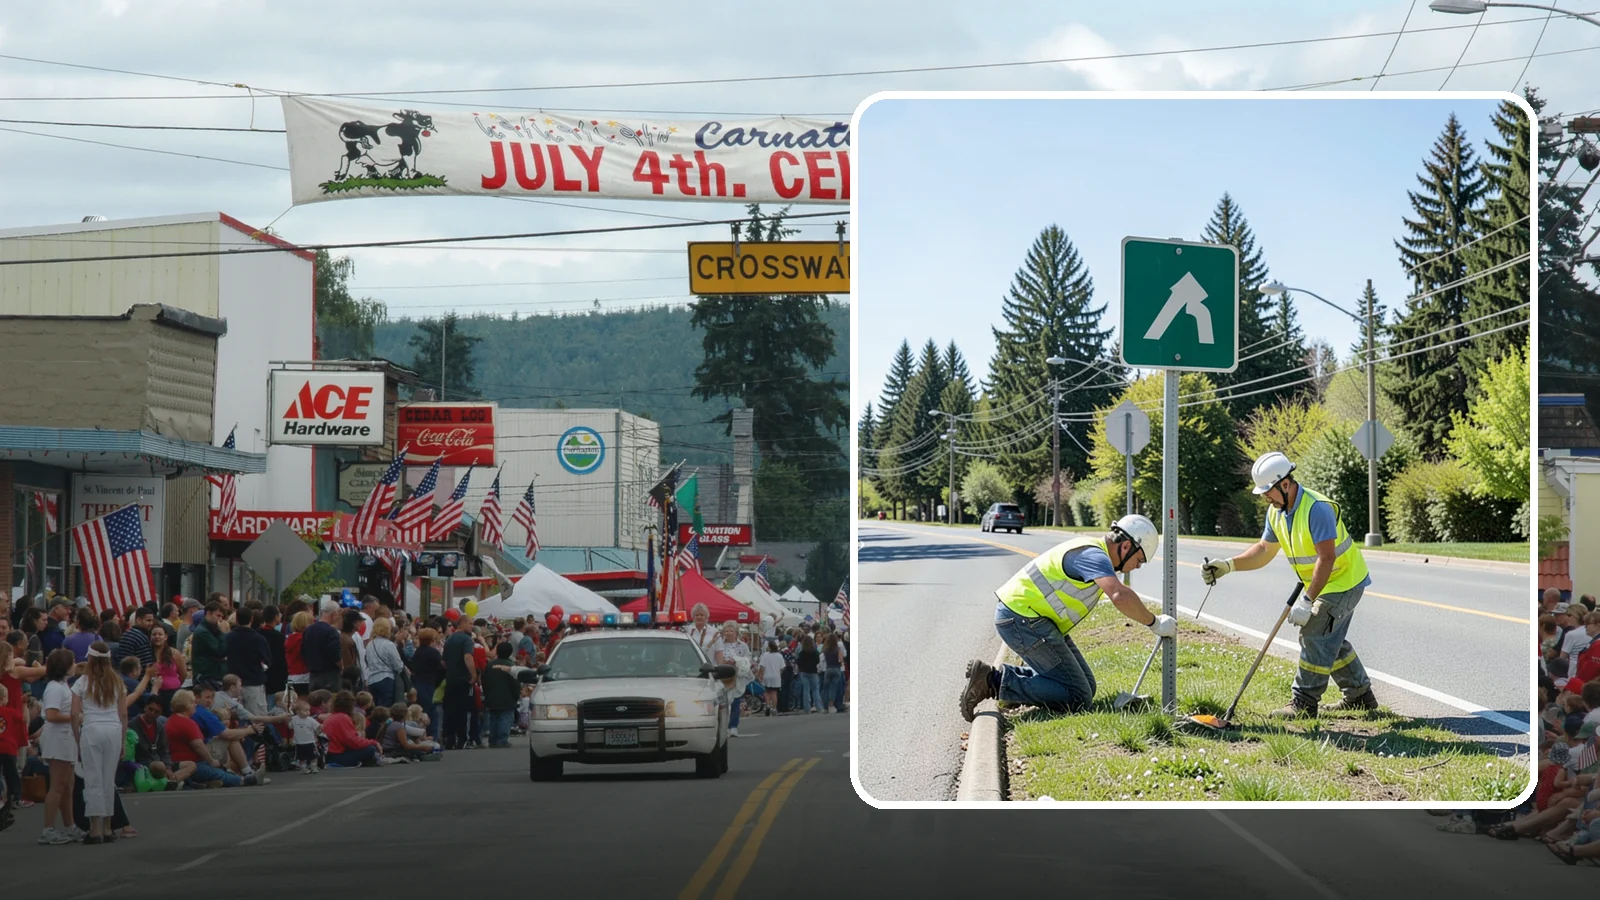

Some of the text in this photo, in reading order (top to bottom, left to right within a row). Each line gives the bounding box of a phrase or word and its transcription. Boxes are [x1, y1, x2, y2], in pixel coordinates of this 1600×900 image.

[481, 141, 604, 192] JULY
[632, 150, 747, 198] 4th.
[697, 254, 851, 280] CROSSWA
[282, 380, 374, 420] ACE
[406, 409, 485, 422] CEDAR LOG
[283, 421, 371, 436] Hardware
[416, 428, 477, 447] Coca-Cola
[354, 467, 385, 481] Simpl
[83, 485, 155, 496] St. Vincent de Paul
[688, 527, 742, 535] CRNATION
[699, 535, 730, 543] GLASS
